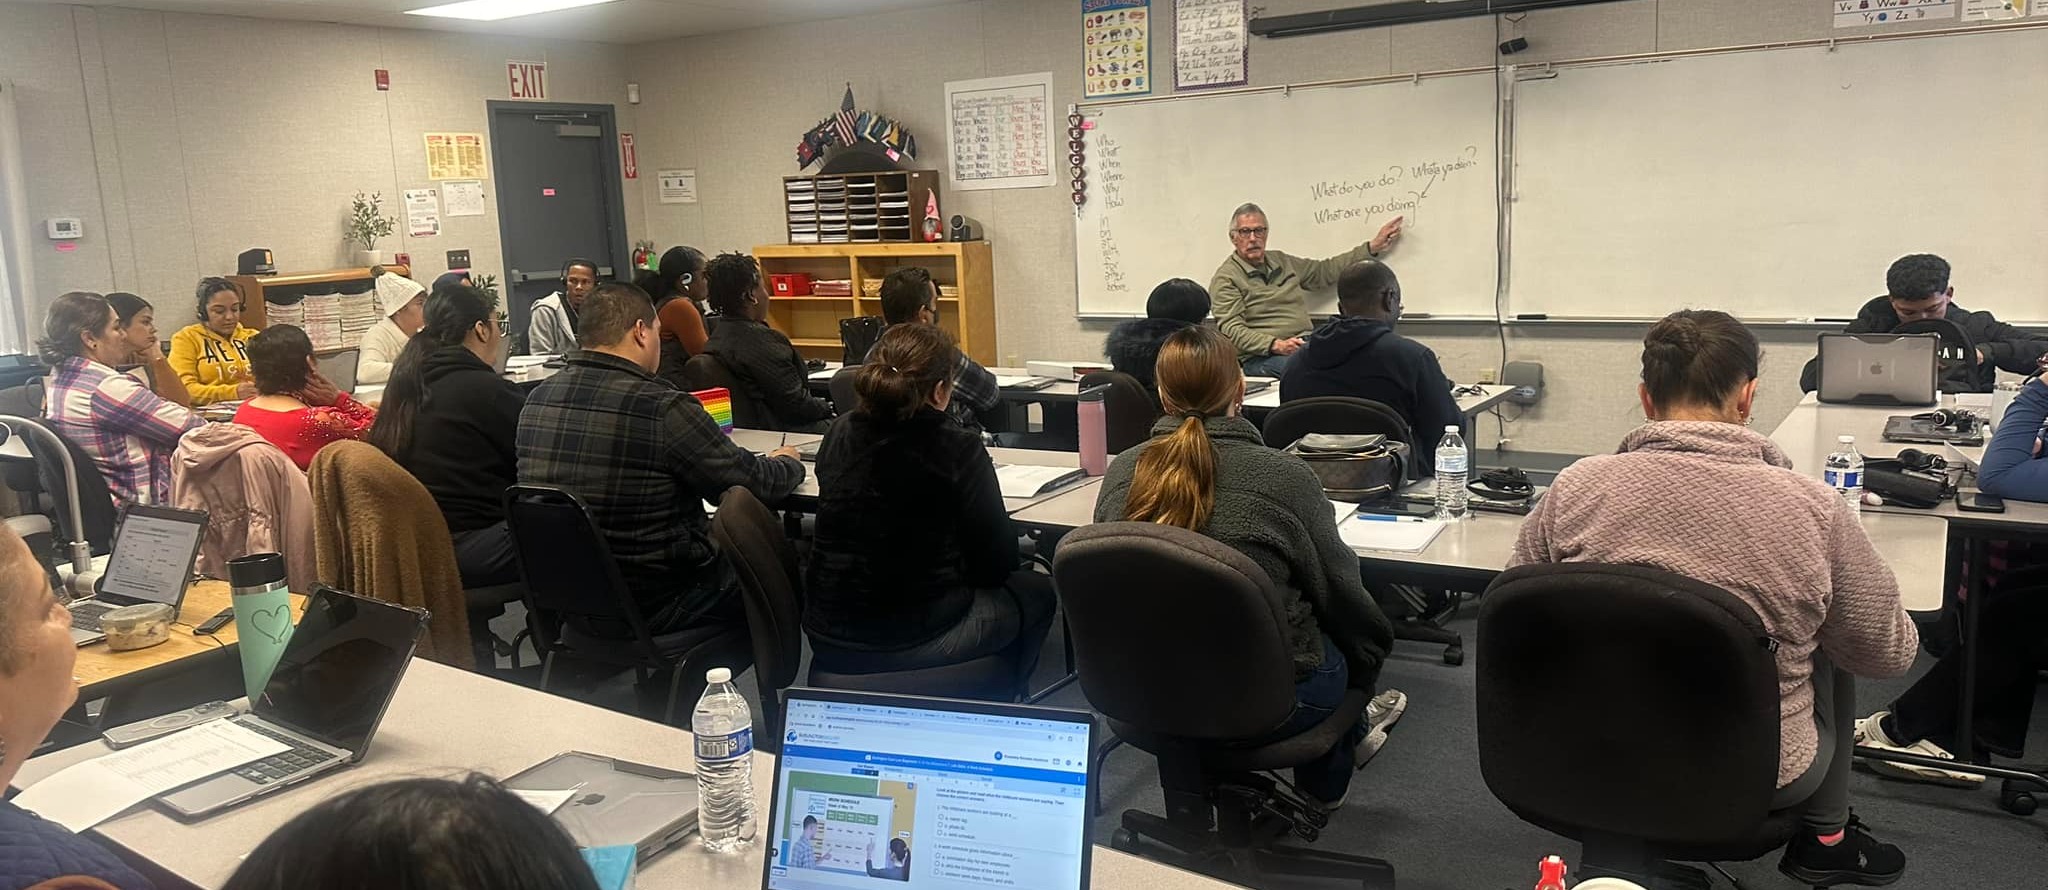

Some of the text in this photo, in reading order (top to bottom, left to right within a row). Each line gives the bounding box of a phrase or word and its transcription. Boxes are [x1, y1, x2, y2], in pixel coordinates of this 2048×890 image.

[1840, 2, 1852, 11] Vv
[1863, 10, 1909, 23] Yy Zz
[508, 64, 544, 98] EXIT
[1096, 133, 1114, 148] Who
[1098, 146, 1121, 158] What
[1099, 158, 1121, 170] When
[1100, 171, 1125, 182] Where
[1311, 165, 1404, 201] What do you do?
[1102, 183, 1119, 200] Why
[1105, 197, 1124, 209] How
[1314, 191, 1421, 229] What are you doing?
